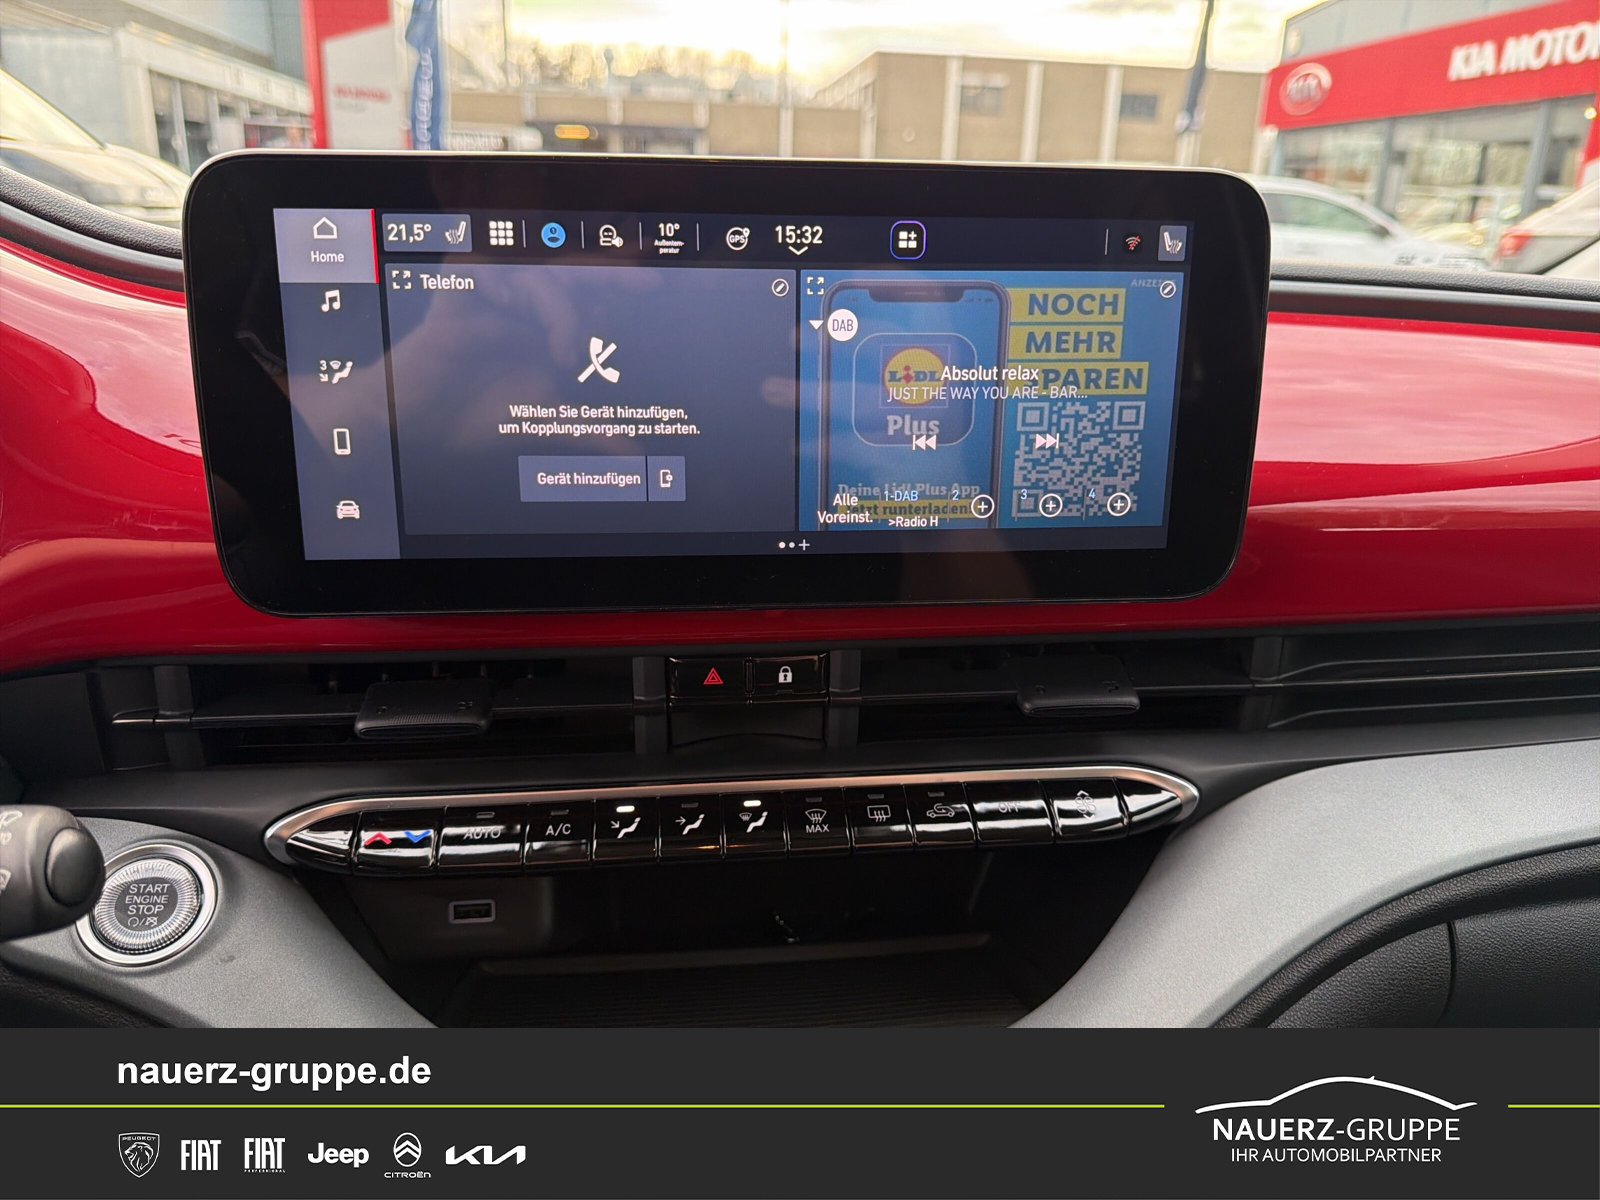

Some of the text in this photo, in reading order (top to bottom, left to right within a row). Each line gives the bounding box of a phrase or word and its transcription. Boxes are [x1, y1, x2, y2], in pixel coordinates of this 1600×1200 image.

[1447, 40, 1497, 81] KIA
[387, 223, 432, 243] 21,5°
[658, 222, 680, 237] 10°
[775, 225, 823, 244] 15:32
[310, 250, 345, 263] Home
[420, 273, 475, 290] Telefon
[1028, 293, 1119, 316] NOCH
[832, 317, 854, 333] DAB
[1026, 331, 1116, 353] MEHR
[940, 364, 1040, 381] Absolut relax
[887, 386, 918, 402] JUST
[922, 386, 947, 400] THE
[950, 386, 979, 400] WAY
[982, 386, 1009, 400] YOU
[1011, 386, 1039, 399] ARE
[510, 405, 689, 421] Wählen Sie Gerät hinzufügen,
[499, 421, 700, 437] um Kopplungsvorgang zu starten.
[886, 414, 940, 436] Plus
[537, 473, 641, 488] Gerät hinzufügen
[833, 494, 859, 506] Alle
[952, 490, 960, 501] 2
[1020, 489, 1028, 500] 3
[1088, 488, 1096, 499] 4
[817, 511, 874, 524] Voreinst.
[930, 517, 938, 527] H
[463, 828, 502, 840] AUTO
[545, 823, 571, 836] A/C
[806, 824, 829, 834] MAX
[129, 883, 170, 894] START
[125, 895, 169, 904] ENGINE
[127, 904, 164, 915] STOP
